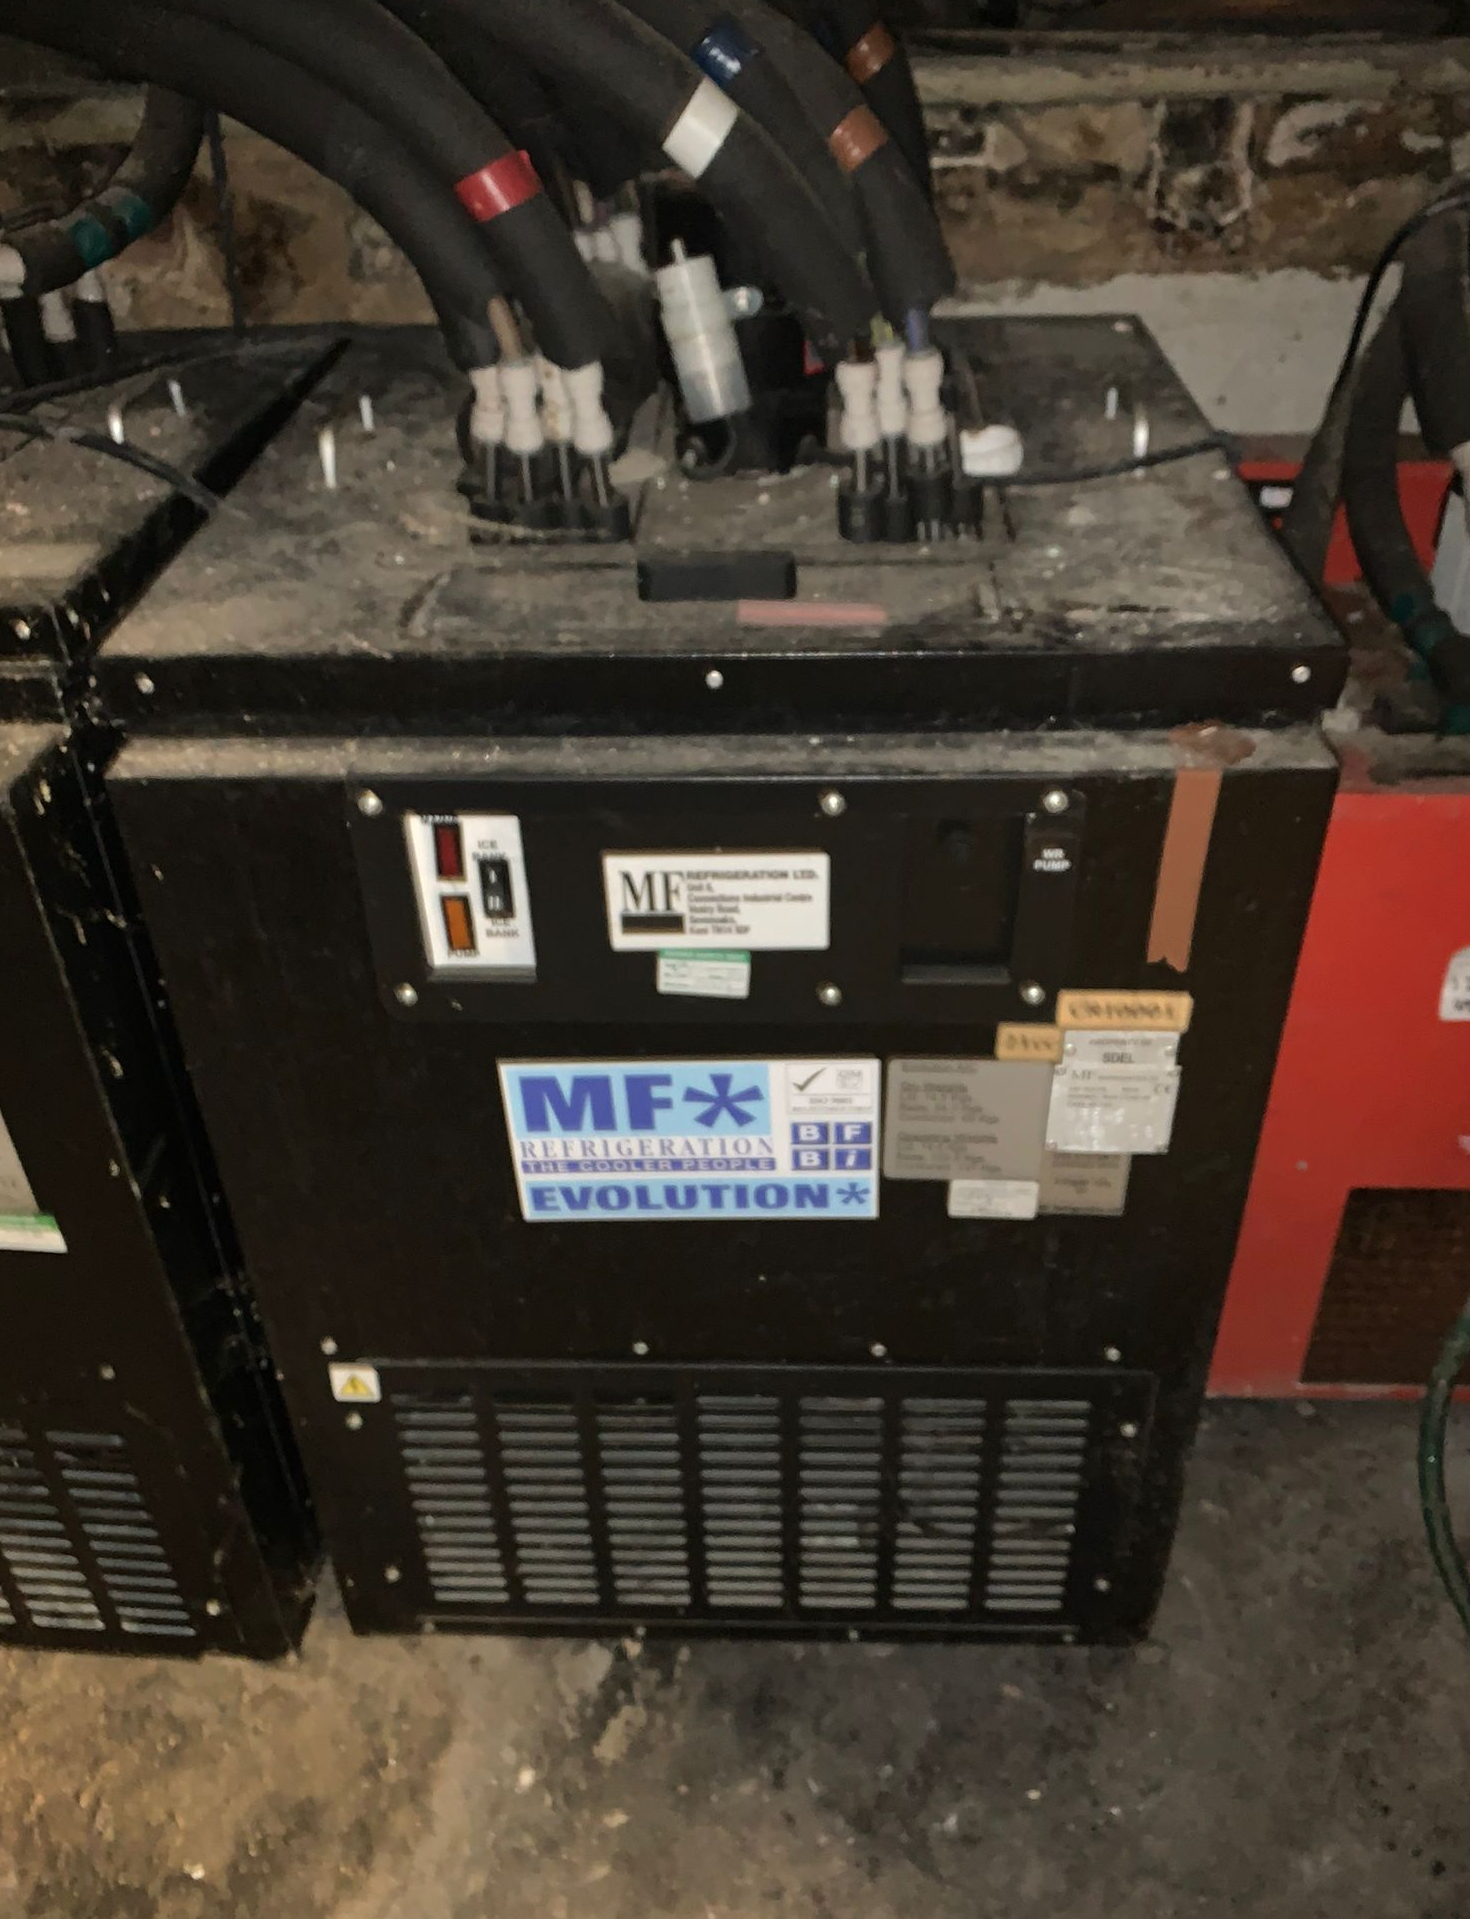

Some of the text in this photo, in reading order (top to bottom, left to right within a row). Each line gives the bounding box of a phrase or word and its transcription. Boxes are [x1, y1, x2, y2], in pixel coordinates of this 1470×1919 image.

[477, 840, 499, 849] ICE
[1033, 859, 1071, 871] PUMP
[618, 870, 686, 913] MF
[686, 869, 789, 881] REFRIGERATION
[486, 929, 520, 938] BANK
[520, 1136, 774, 1159] REFRIGERATION
[527, 1158, 774, 1173] THE COOLER PEOPLE
[529, 1182, 829, 1212] EVOLUTION
